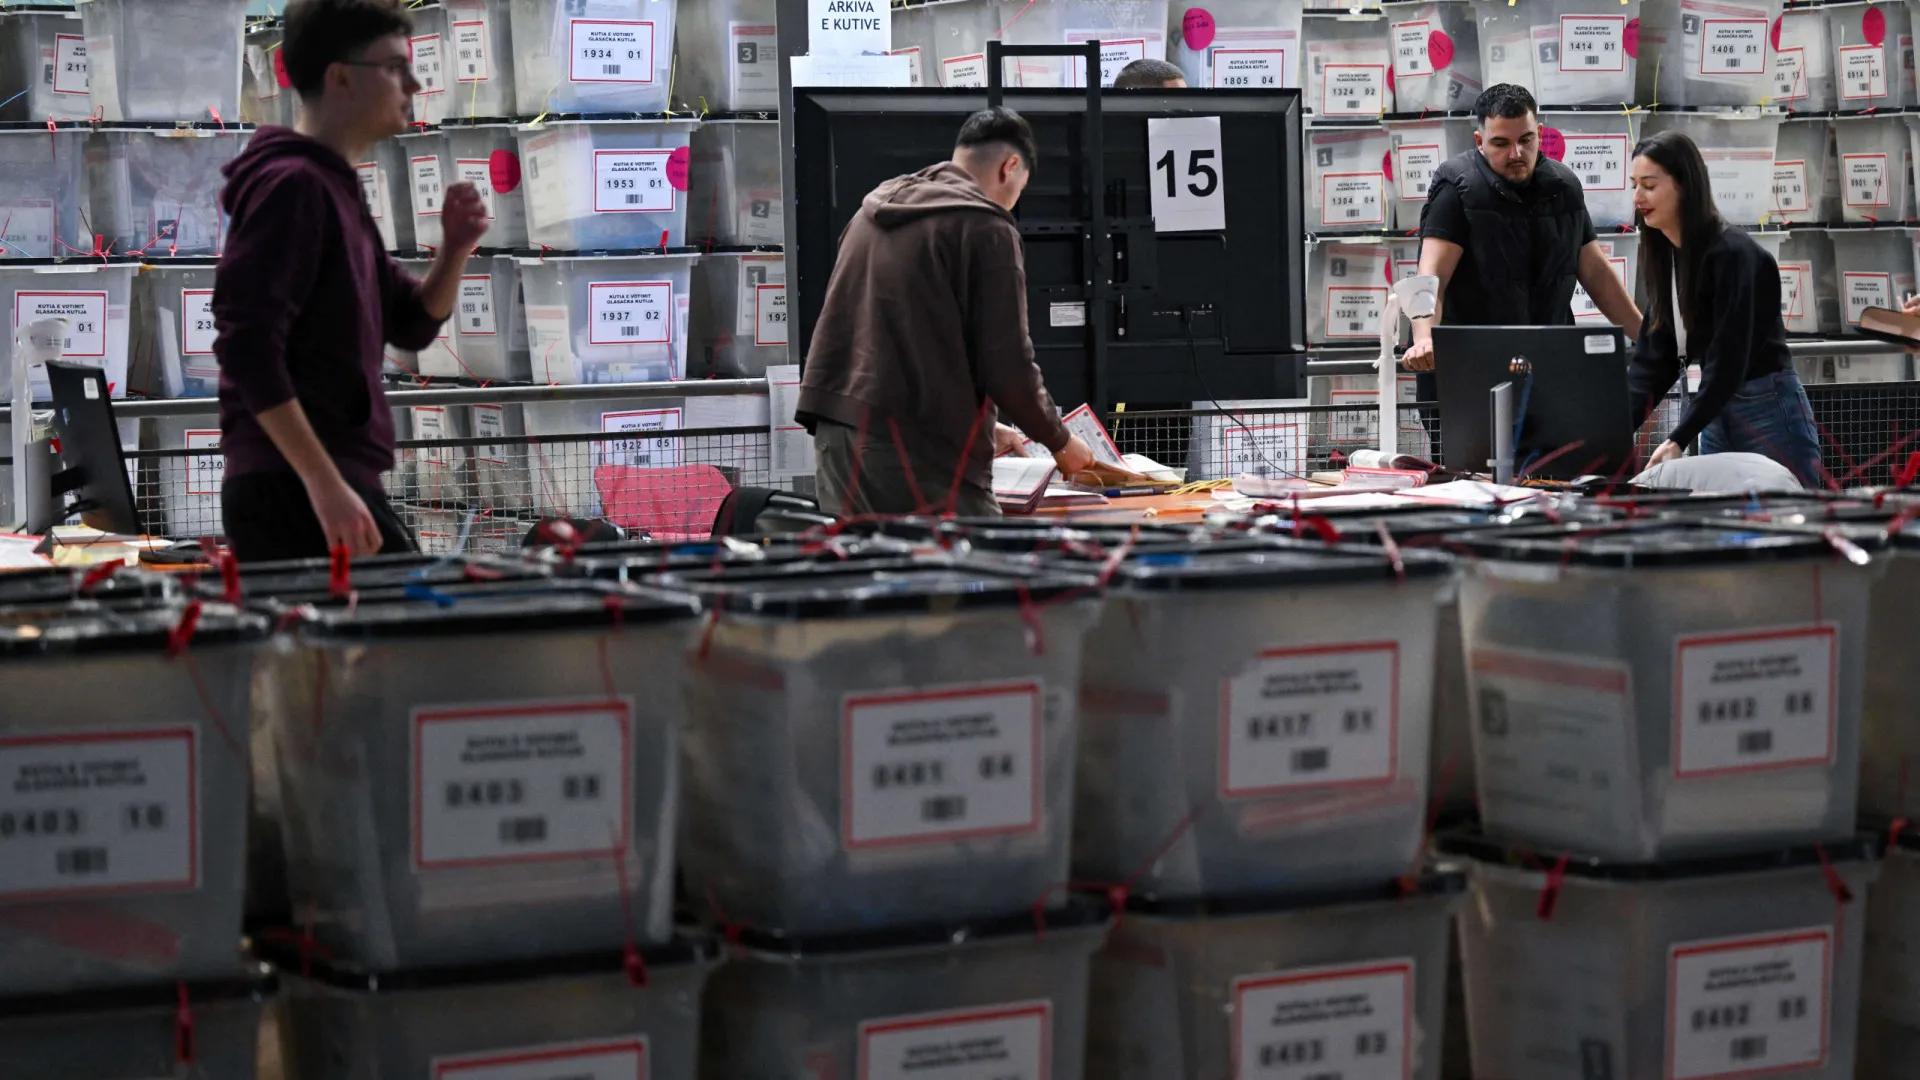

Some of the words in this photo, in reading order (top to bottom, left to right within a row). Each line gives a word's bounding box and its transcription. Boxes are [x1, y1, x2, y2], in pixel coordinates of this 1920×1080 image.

[828, 1, 875, 12] ARKIVA
[822, 18, 829, 30] E
[834, 18, 880, 30] KUTIVE
[1685, 20, 1694, 32] 1
[1570, 42, 1592, 50] 1414
[1604, 42, 1614, 50] 01
[1712, 45, 1734, 53] 1406
[1746, 45, 1756, 53] 01
[584, 50, 612, 58] 1934
[628, 50, 641, 58] 01
[742, 47, 753, 60] 3
[1546, 48, 1555, 59] 1
[1224, 77, 1248, 85] 1805
[1333, 88, 1354, 96] 1324
[1364, 88, 1376, 96] 02
[1322, 153, 1329, 164] 1
[1570, 162, 1593, 170] 1417
[1605, 162, 1617, 170] 01
[1157, 149, 1218, 198] 15
[607, 179, 634, 188] 1953
[650, 179, 662, 188] 01
[1332, 196, 1353, 205] 1304
[1364, 196, 1375, 204] 04
[756, 204, 765, 216] 2
[602, 312, 630, 321] 1937
[646, 311, 660, 320] 02
[1336, 309, 1357, 318] 1321
[1368, 309, 1378, 318] 04
[78, 323, 93, 332] 01
[615, 441, 642, 451] 1922
[657, 439, 670, 448] 05
[1277, 450, 1288, 459] 01
